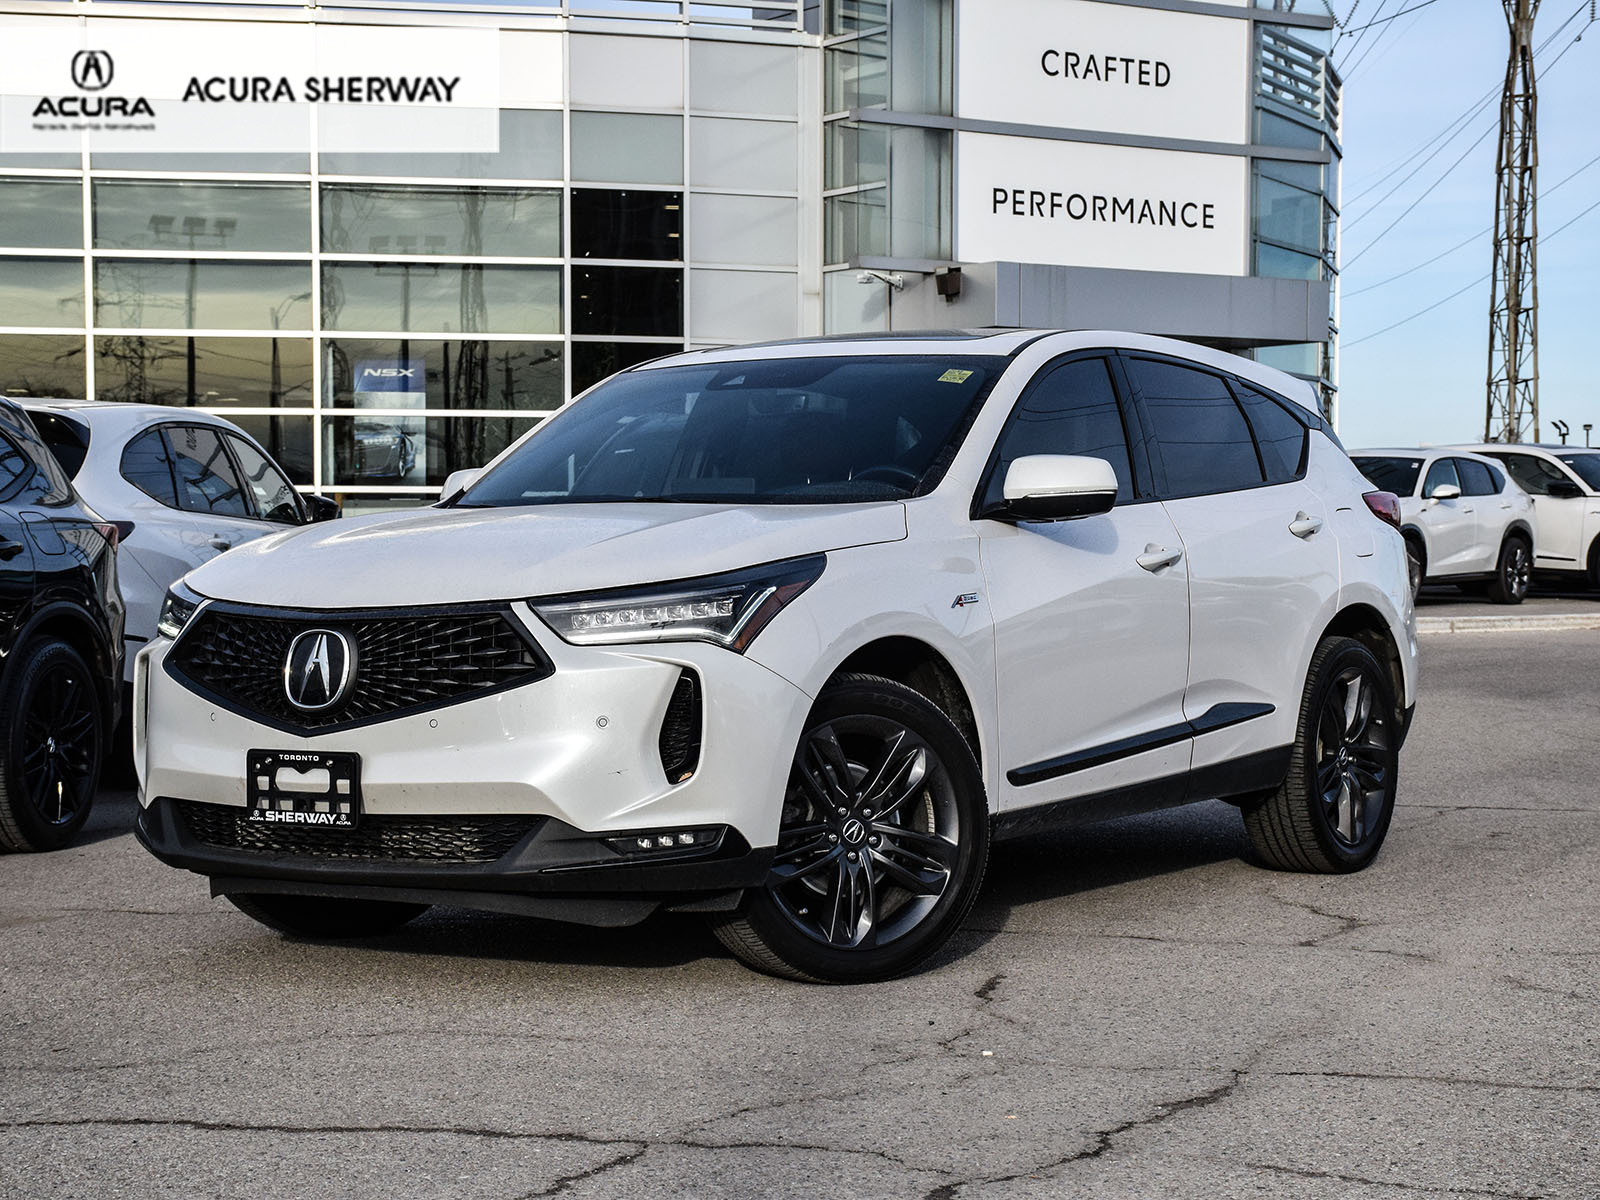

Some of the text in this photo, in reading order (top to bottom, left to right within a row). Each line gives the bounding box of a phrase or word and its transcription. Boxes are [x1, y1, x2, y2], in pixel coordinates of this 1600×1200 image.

[1041, 49, 1171, 87] CRAFTED
[992, 187, 1215, 229] PERFORMANCE
[363, 368, 415, 377] NSX
[278, 753, 320, 762] TORONTO
[265, 810, 337, 825] SHERWAY
